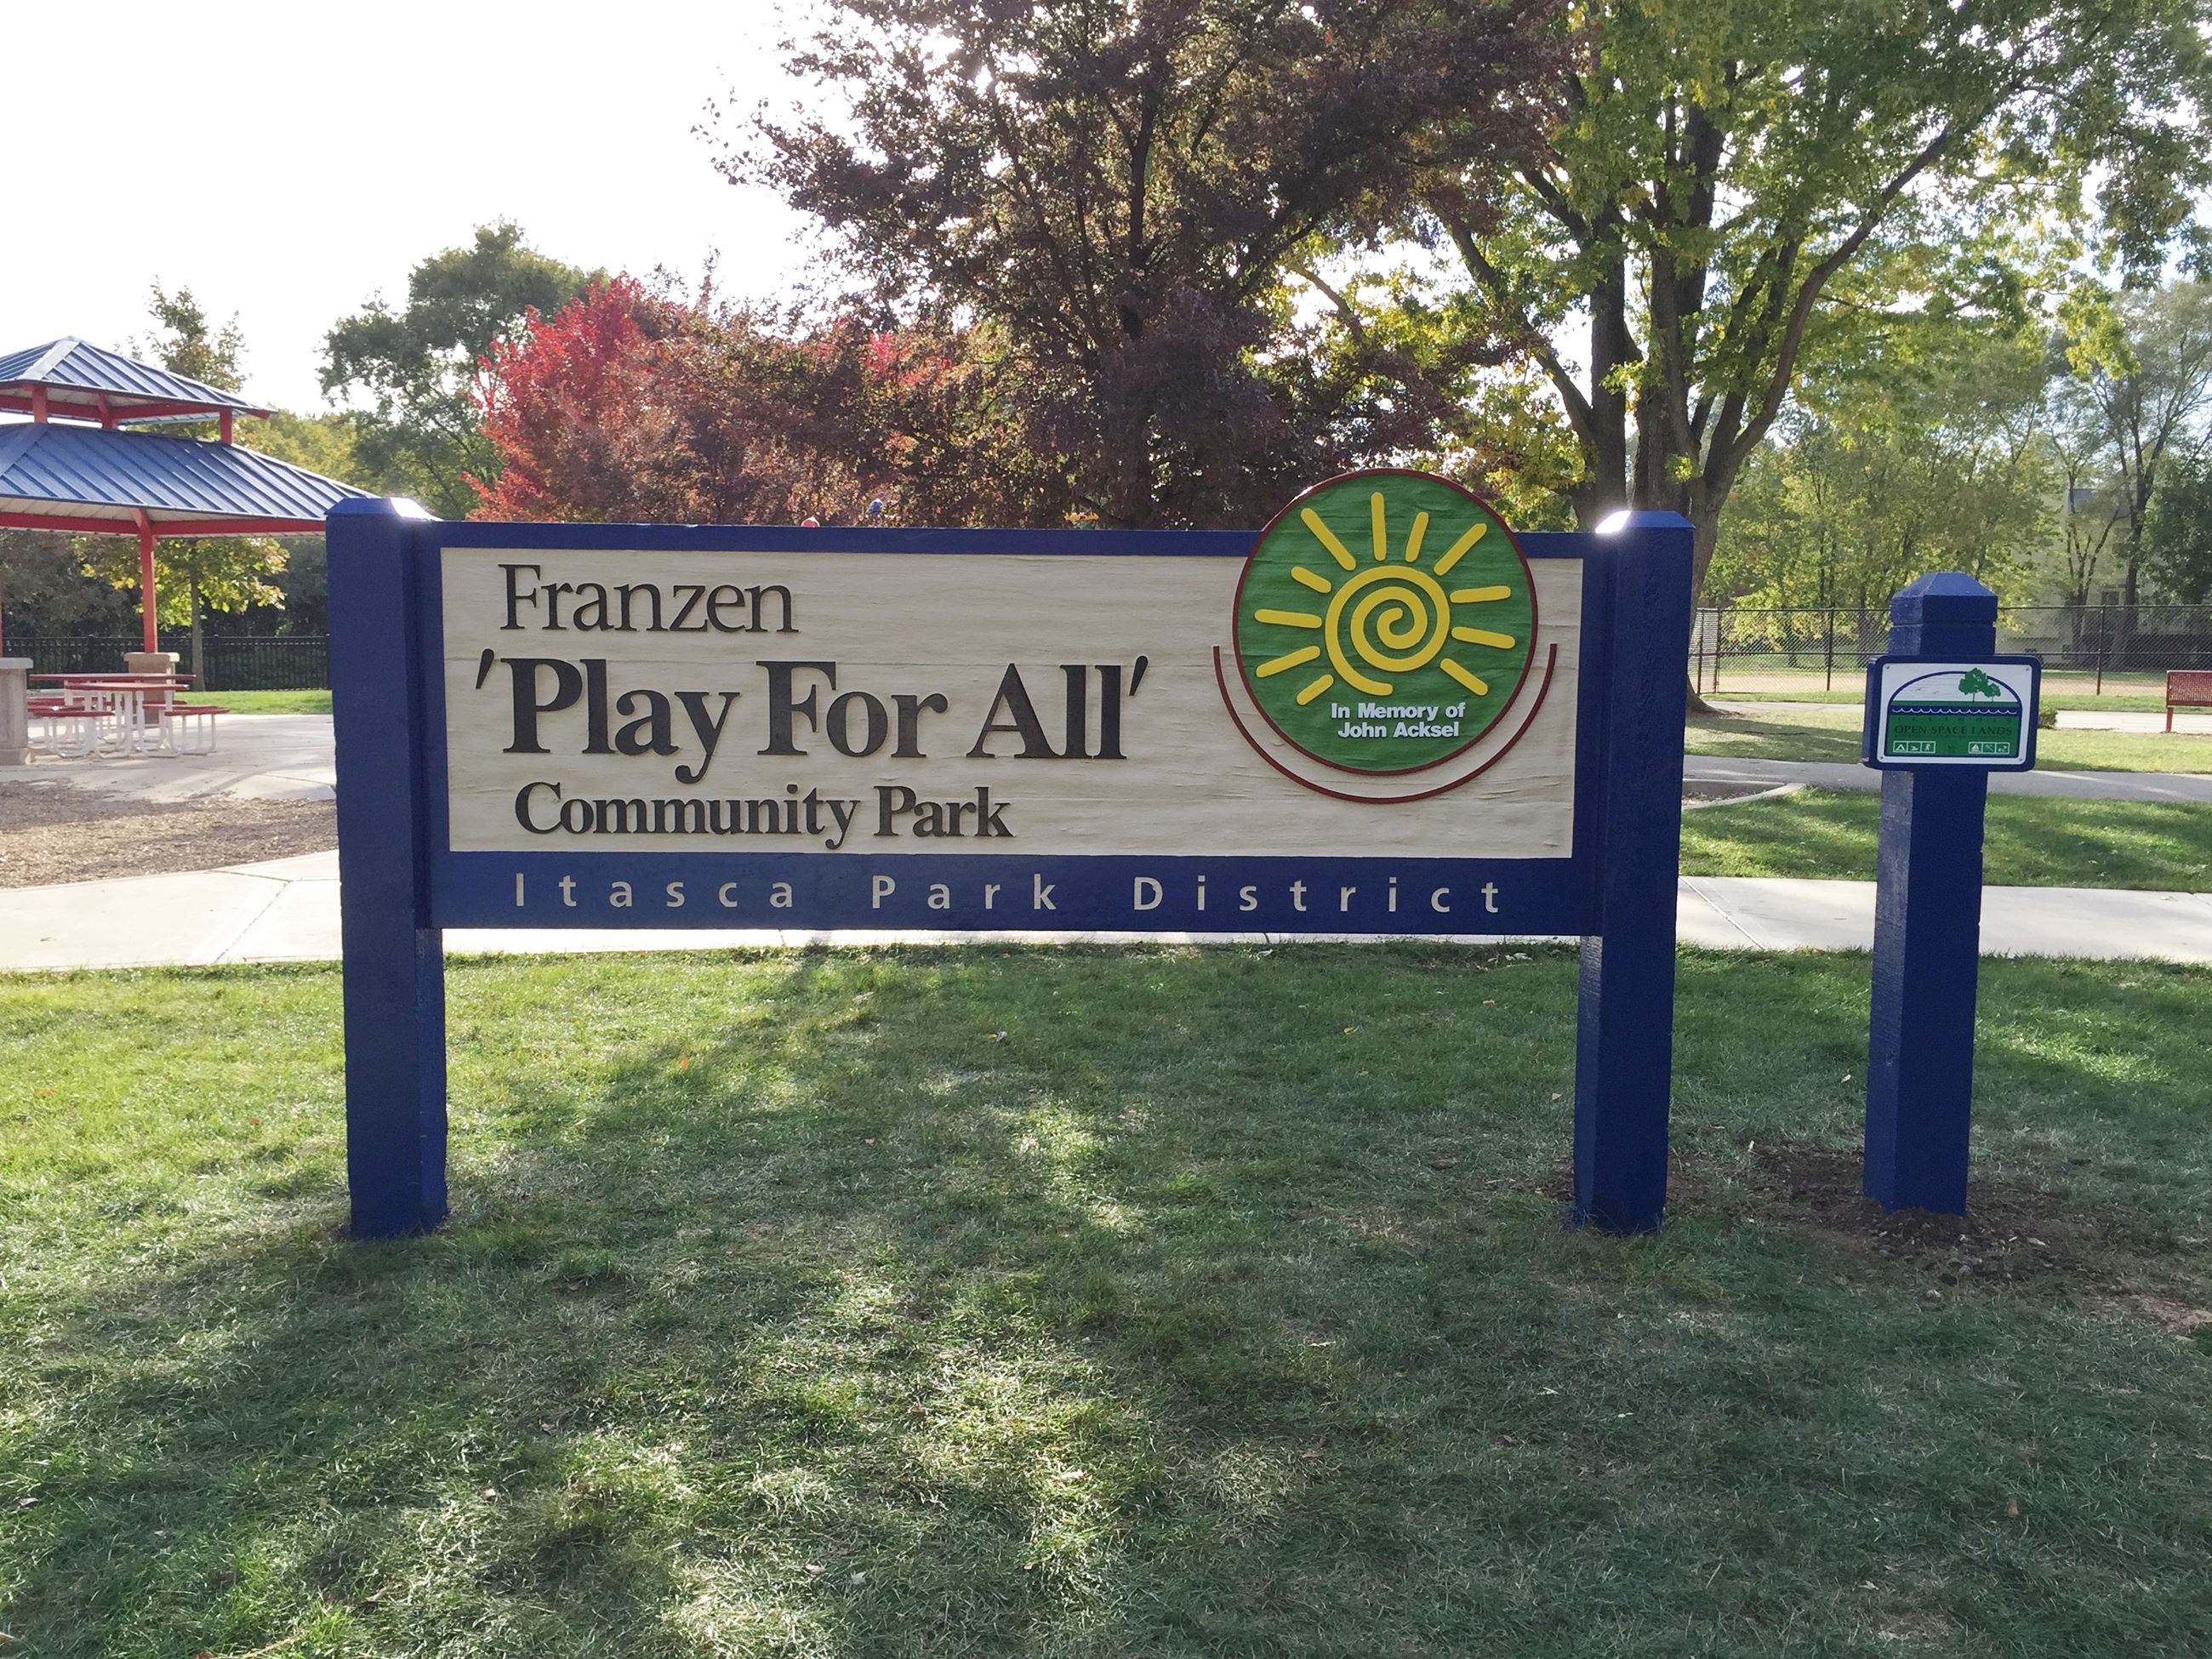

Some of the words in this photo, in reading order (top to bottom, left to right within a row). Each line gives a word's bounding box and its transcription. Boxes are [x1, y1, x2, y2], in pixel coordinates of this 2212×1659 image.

[498, 564, 799, 633] Franzen
[476, 649, 741, 784] 'Play
[756, 661, 948, 758] For
[966, 656, 1149, 760] All'
[1330, 701, 1351, 719] In
[1357, 701, 1440, 721] Memory
[1445, 701, 1467, 719] of
[1337, 721, 1388, 738] John
[1393, 720, 1460, 738] Acksel
[1894, 725, 1928, 734] OPEN
[1931, 725, 1968, 735] SPACE
[1970, 726, 2013, 736] LANDS
[516, 782, 861, 850] Community
[874, 785, 1015, 838] Park
[515, 873, 793, 908] Itasca
[872, 874, 1058, 910] Park
[1133, 875, 1498, 912] District
